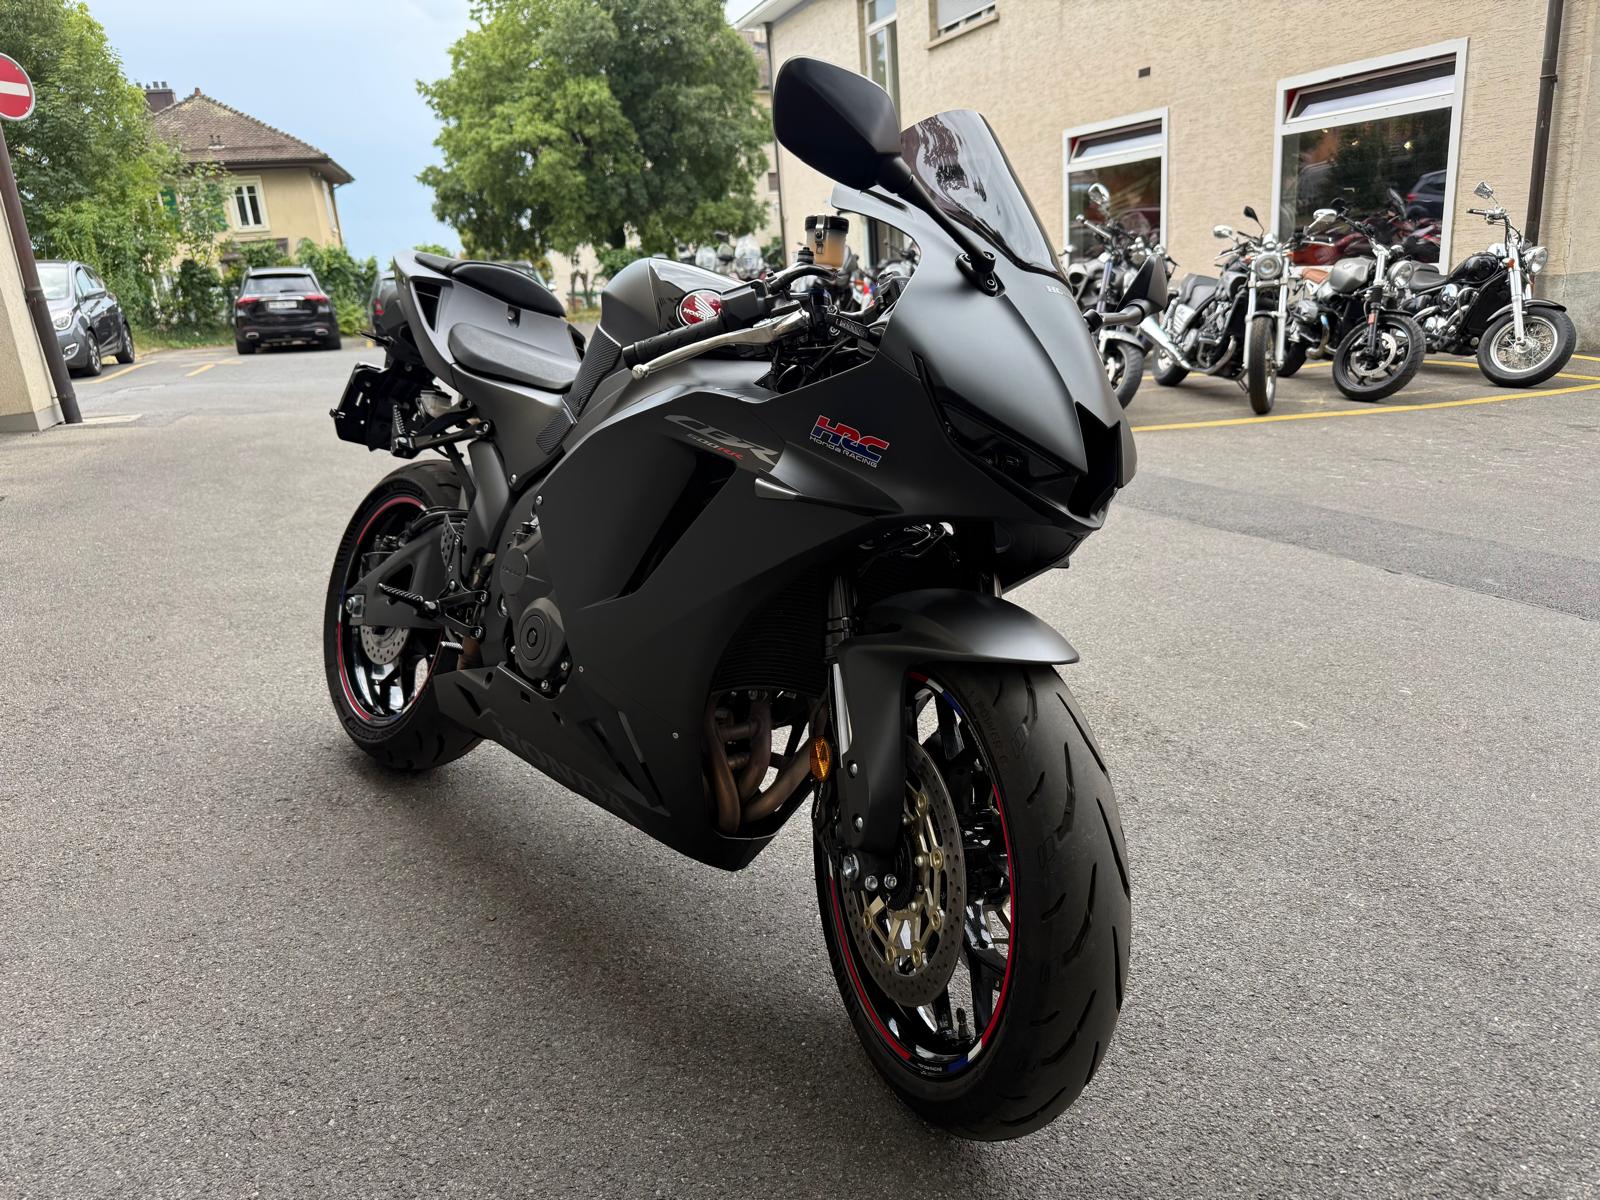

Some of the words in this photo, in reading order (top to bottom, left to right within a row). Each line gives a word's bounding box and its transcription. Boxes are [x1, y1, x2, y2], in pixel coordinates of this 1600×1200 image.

[682, 307, 707, 321] HOND
[663, 414, 779, 466] CBR
[808, 435, 842, 453] Honda
[842, 449, 878, 468] RACING
[810, 414, 891, 464] HRC
[492, 717, 645, 824] HONDA
